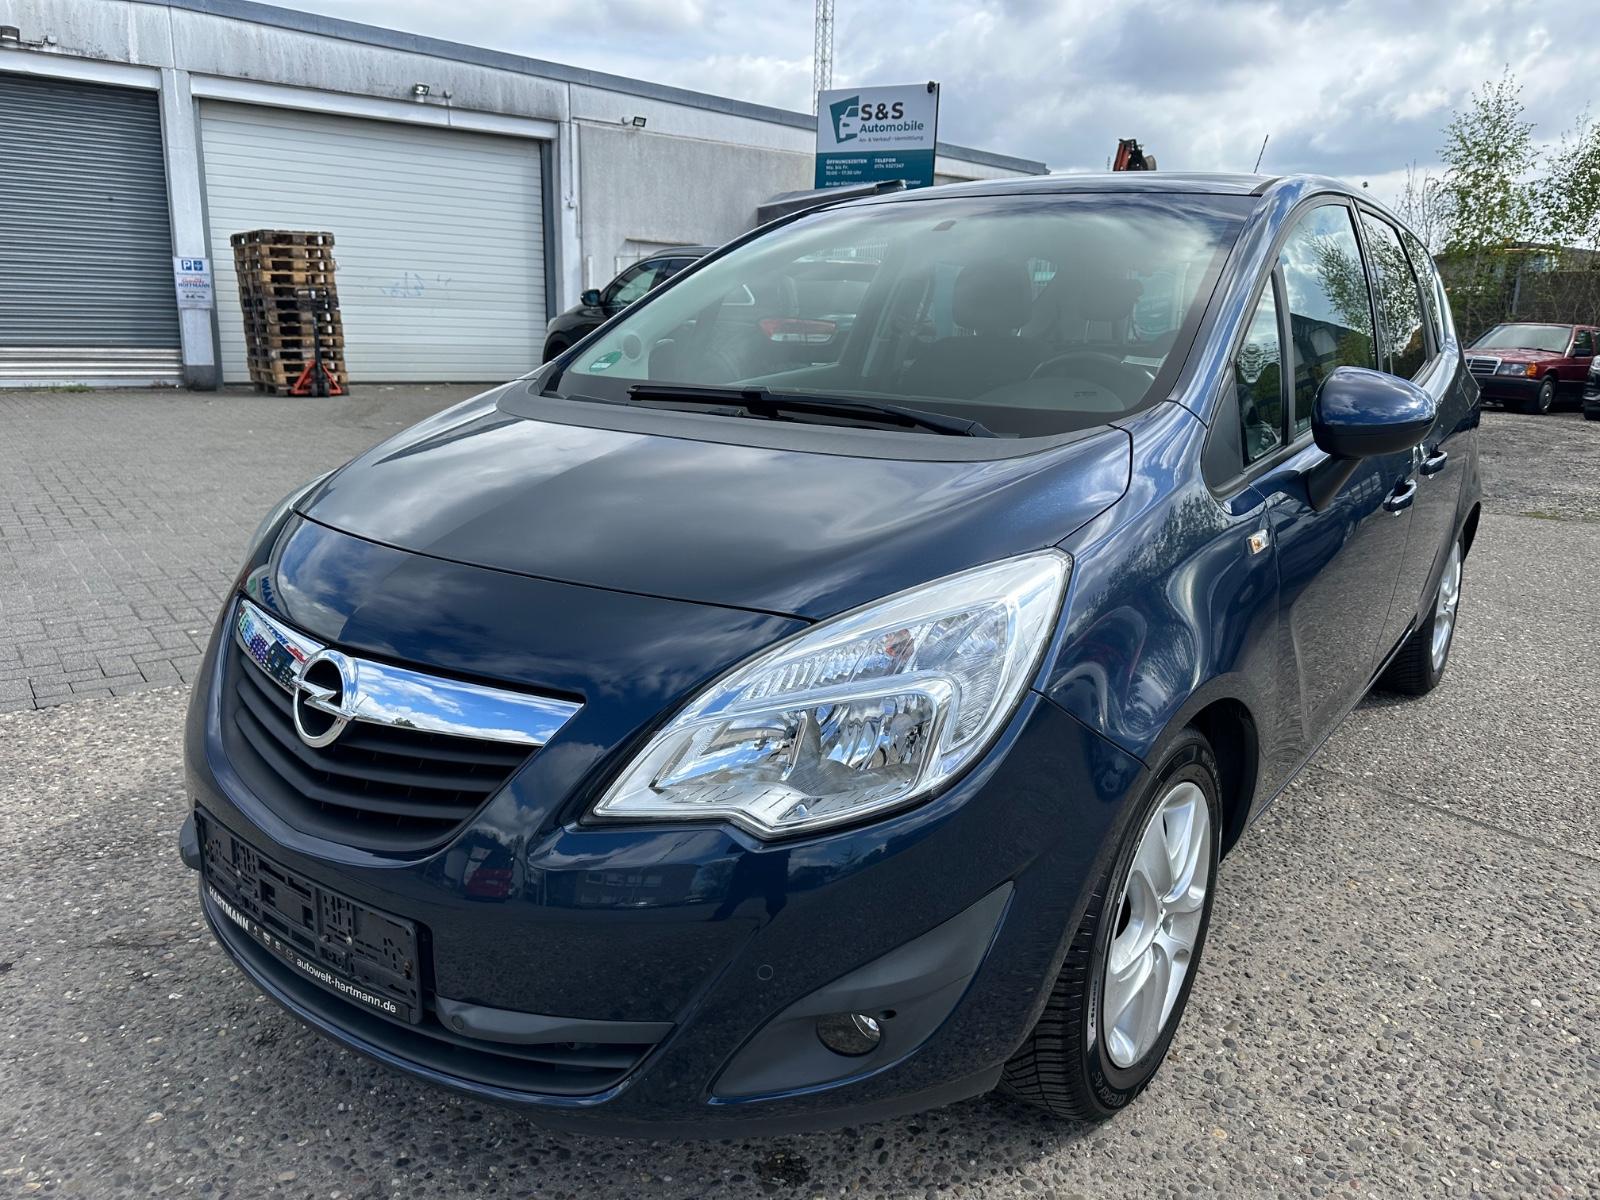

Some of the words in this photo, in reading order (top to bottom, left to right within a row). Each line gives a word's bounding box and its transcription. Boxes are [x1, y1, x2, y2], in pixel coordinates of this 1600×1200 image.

[859, 120, 924, 133] Automobile
[860, 102, 904, 121] S&S
[209, 885, 249, 931] HARTMANN
[296, 958, 397, 1014] autowelt-hartmann.de
